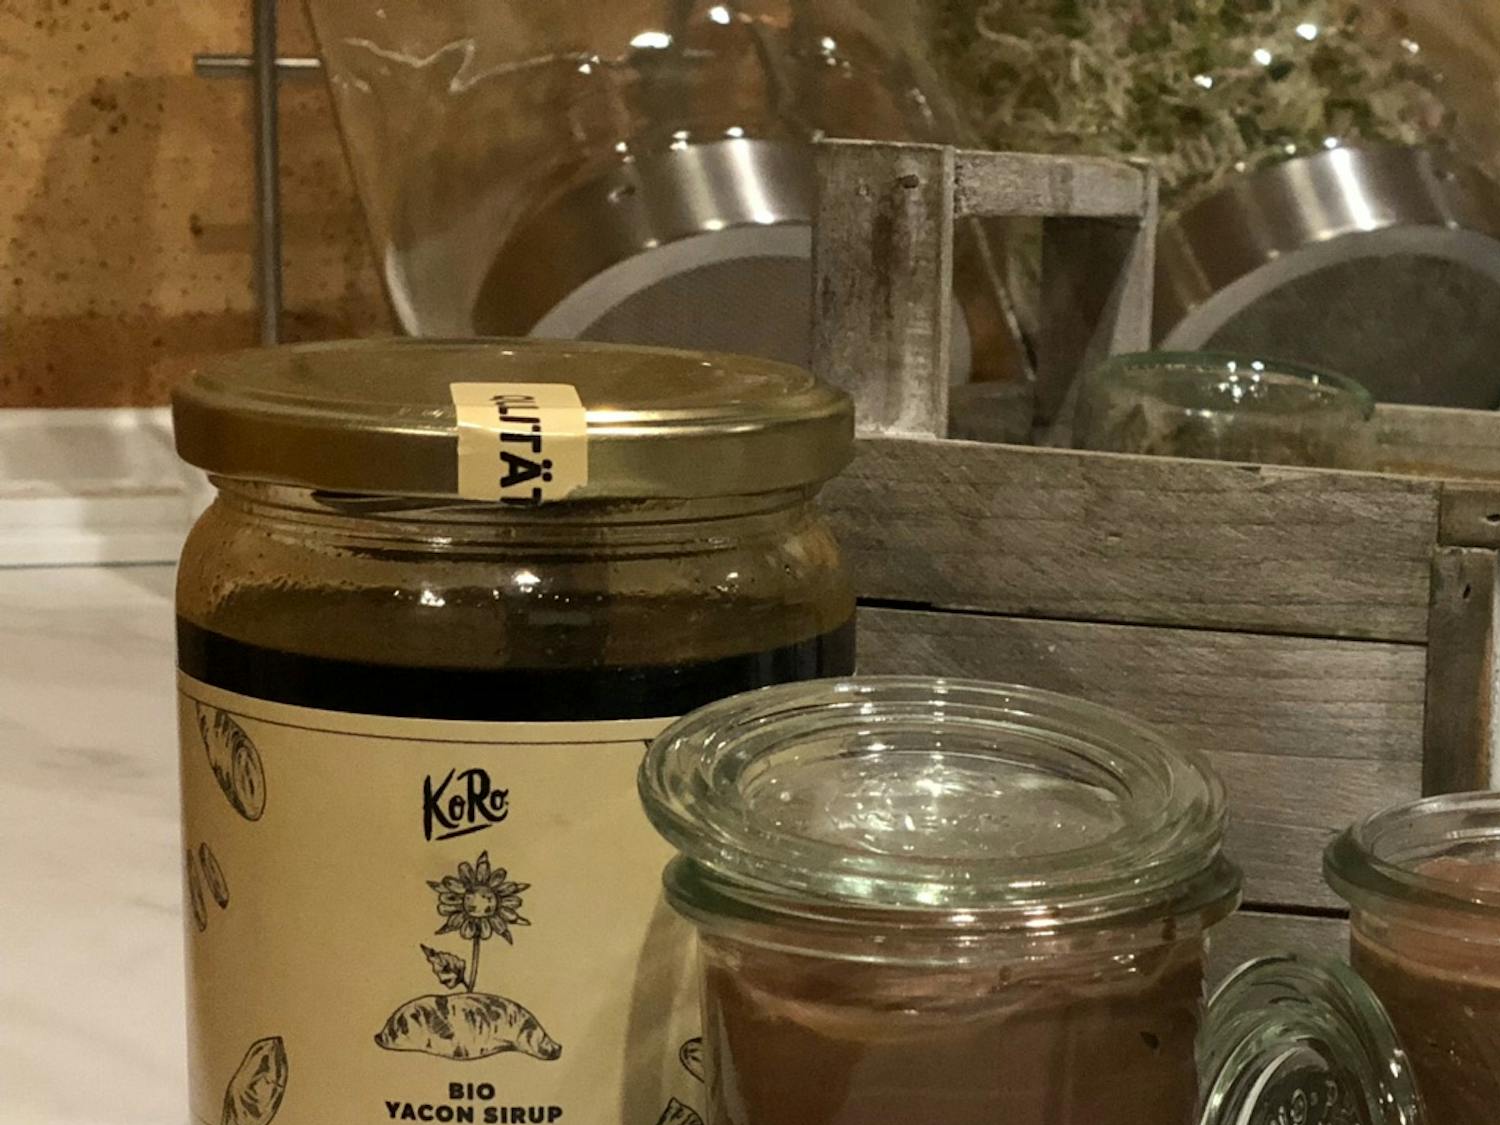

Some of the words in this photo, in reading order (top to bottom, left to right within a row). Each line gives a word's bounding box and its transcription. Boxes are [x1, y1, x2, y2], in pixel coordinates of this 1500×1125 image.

[423, 768, 509, 842] KoRo
[448, 1082, 496, 1100] BIO
[384, 1101, 475, 1123] YACON
[483, 1106, 563, 1125] SIRUP
